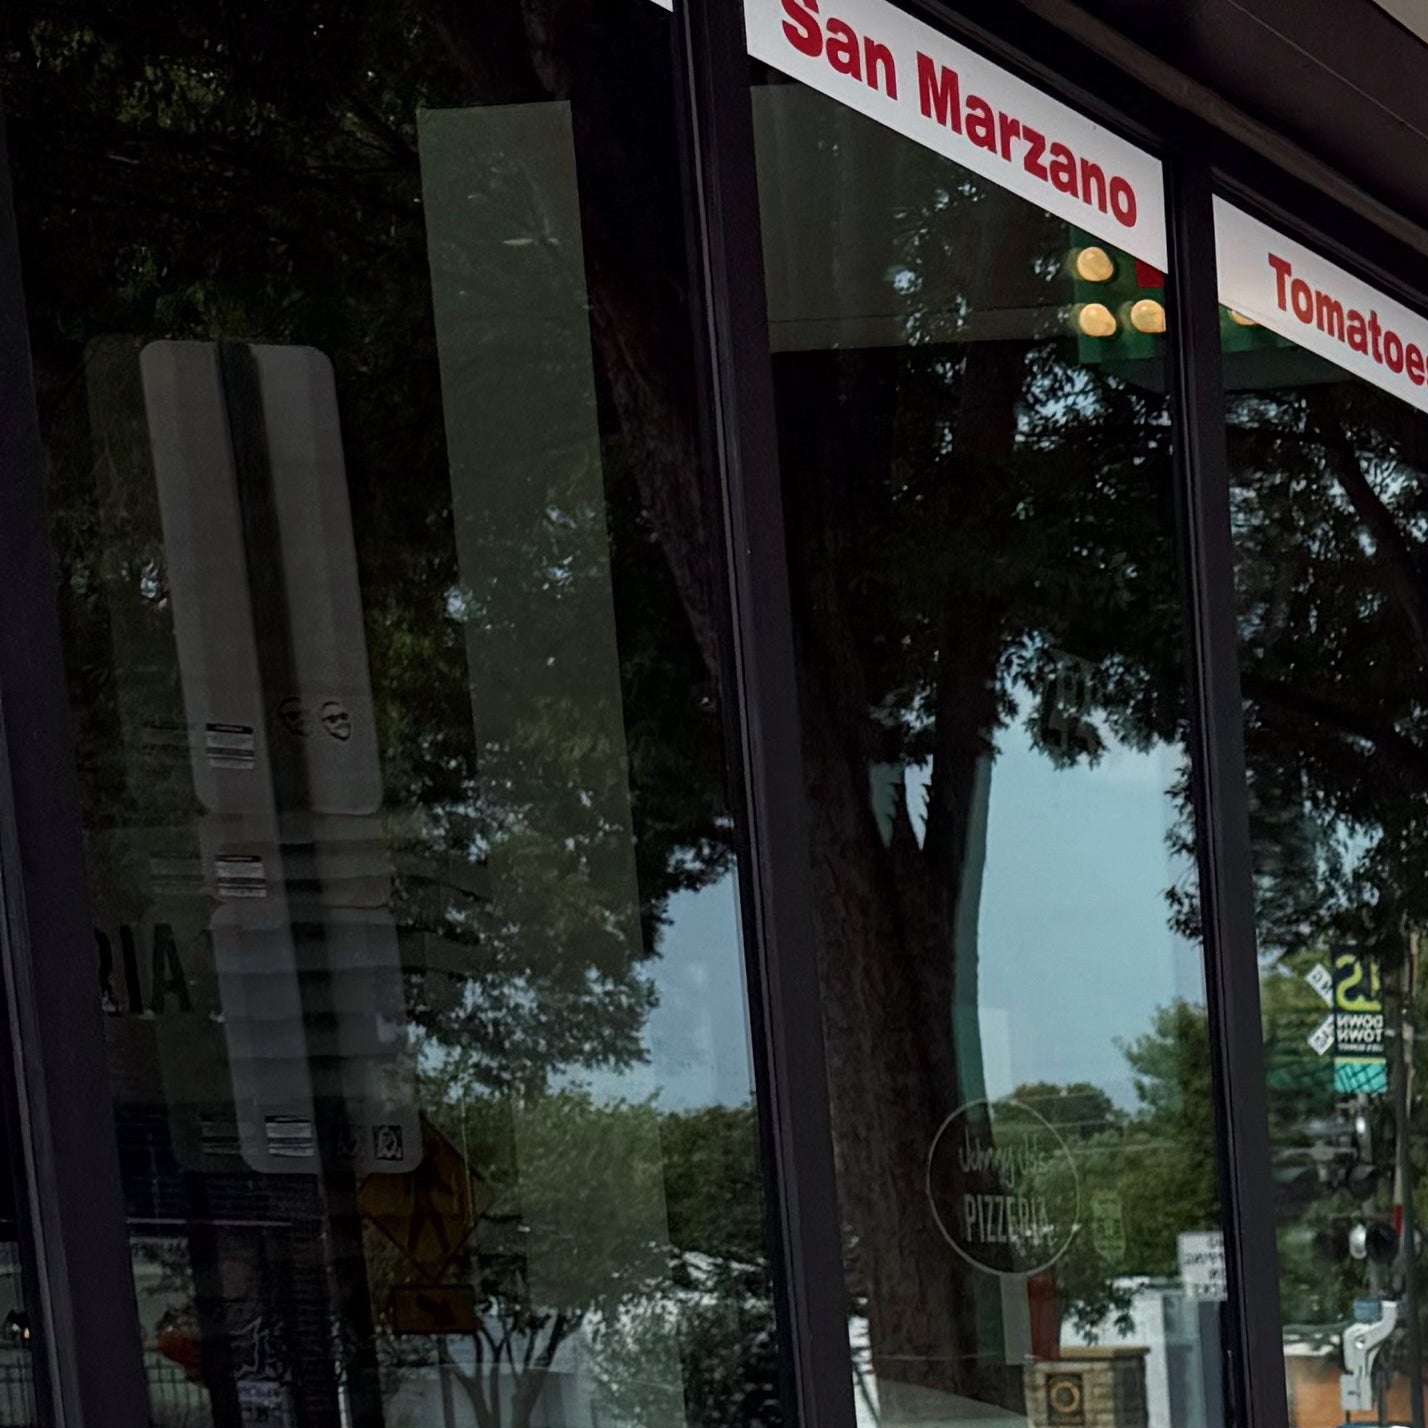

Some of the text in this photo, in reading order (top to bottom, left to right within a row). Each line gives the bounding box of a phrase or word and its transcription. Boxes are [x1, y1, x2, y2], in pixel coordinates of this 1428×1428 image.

[782, 0, 1138, 229] San Marzano
[963, 1193, 1054, 1245] PIZZERIA
